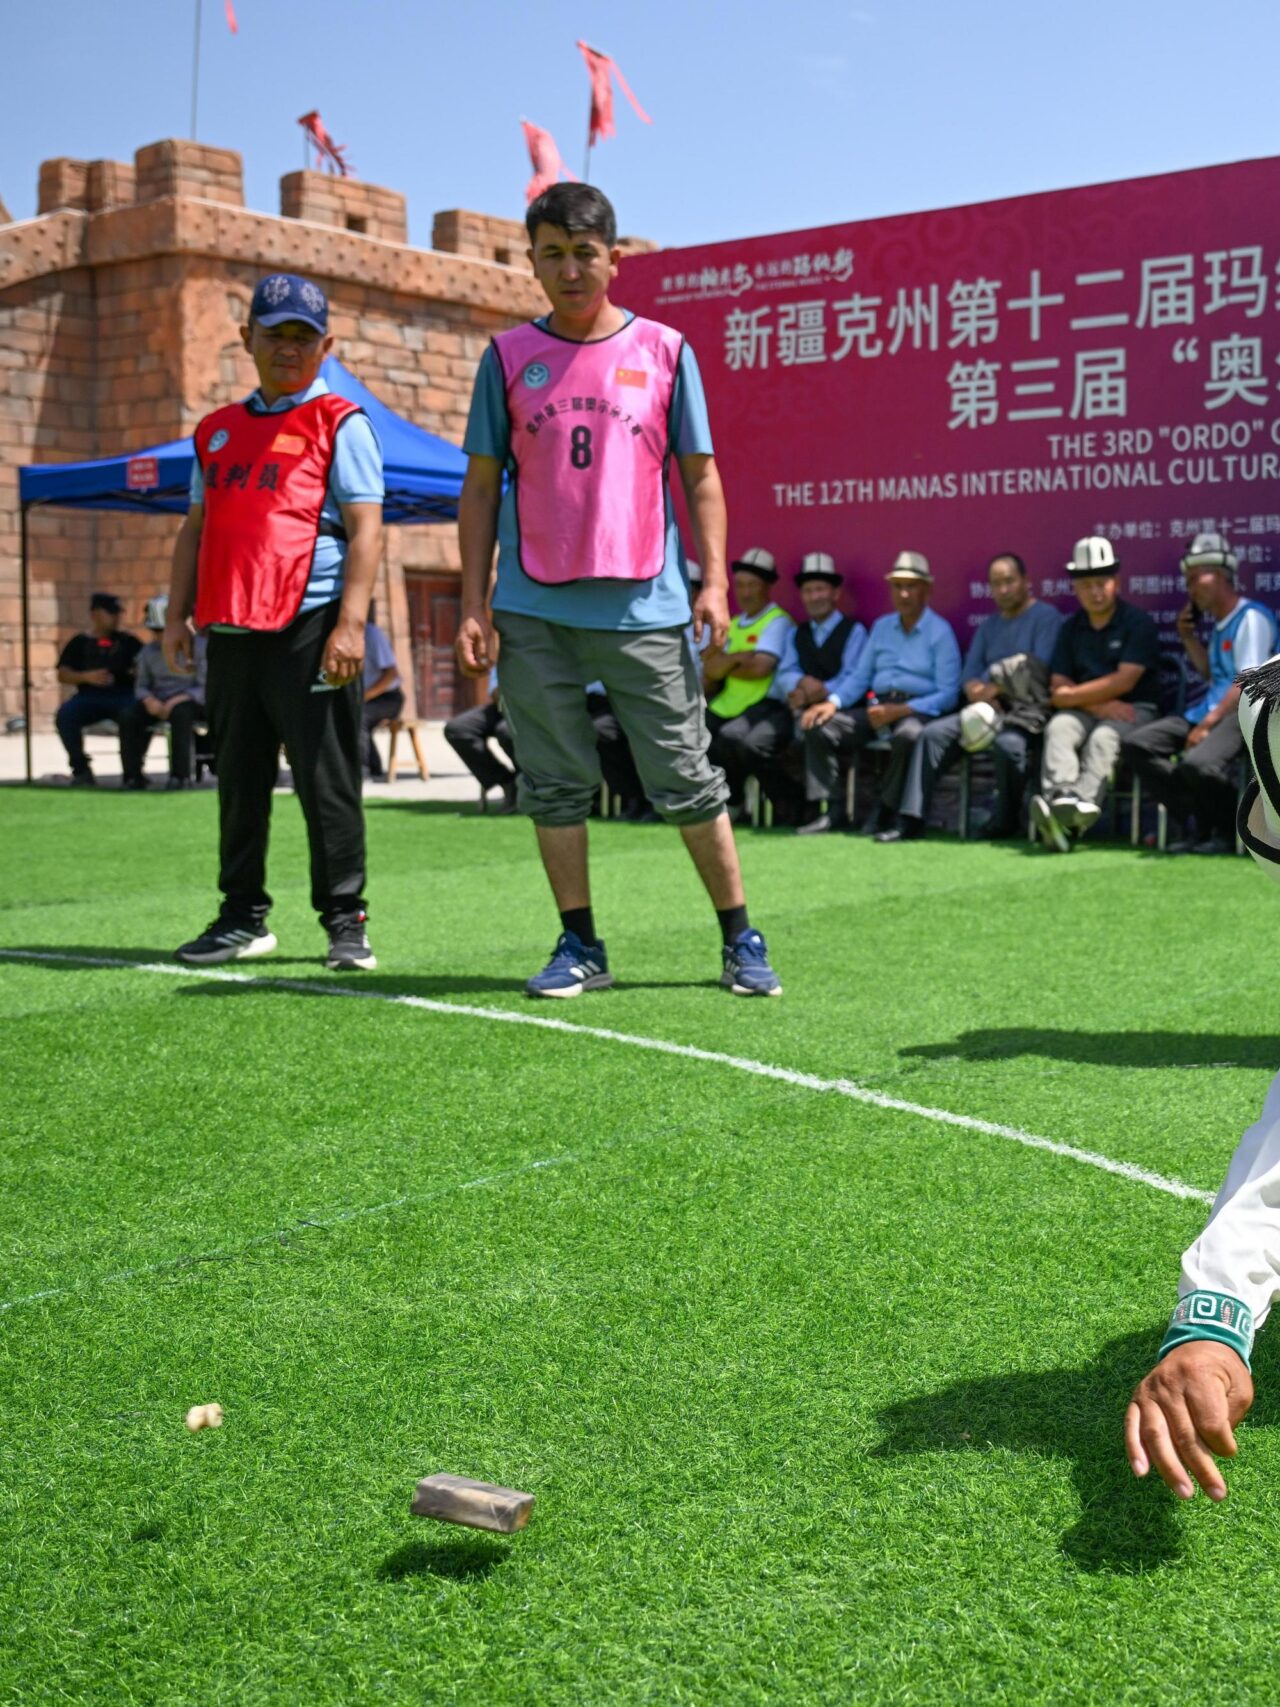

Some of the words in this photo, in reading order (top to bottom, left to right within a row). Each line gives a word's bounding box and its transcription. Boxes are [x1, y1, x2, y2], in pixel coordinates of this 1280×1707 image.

[946, 348, 1128, 430] 第三届
[570, 425, 592, 470] 8
[1047, 433, 1097, 460] THE
[1102, 428, 1153, 457] 3RD
[1159, 418, 1265, 452] "ORDO"
[773, 481, 815, 507] THE
[819, 477, 874, 505] 12TH
[878, 472, 959, 501] MANAS
[961, 460, 1163, 496] INTERNATIONAL
